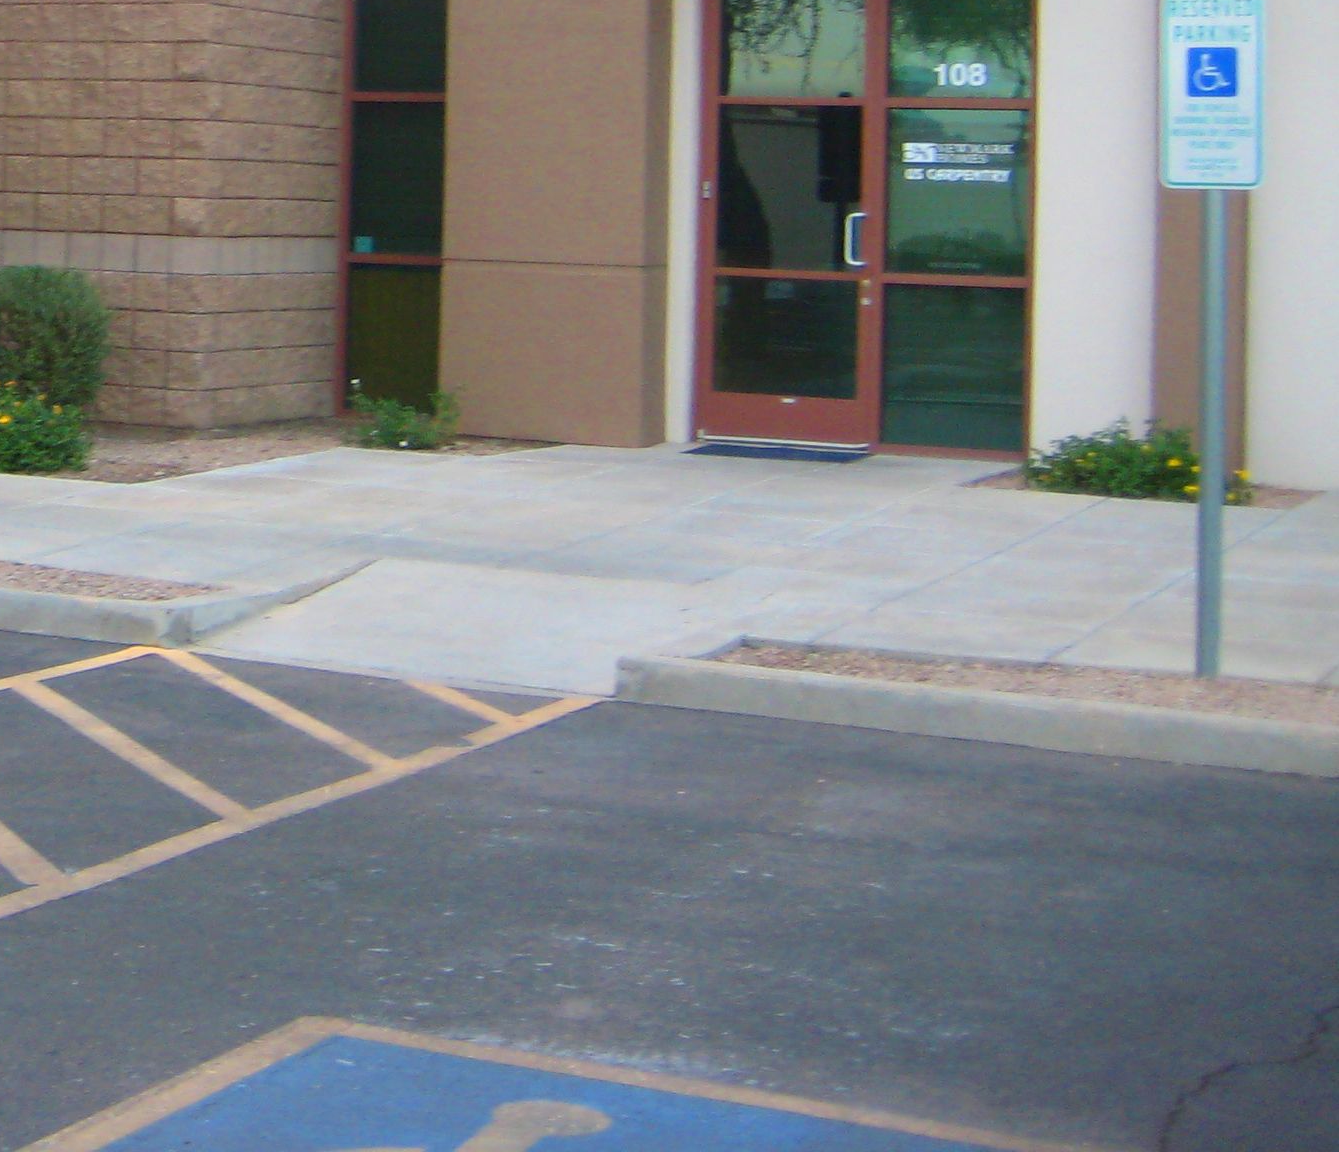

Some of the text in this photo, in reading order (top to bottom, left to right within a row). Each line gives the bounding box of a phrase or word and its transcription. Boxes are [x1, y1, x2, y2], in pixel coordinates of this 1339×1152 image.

[1169, 0, 1253, 17] RESERVED
[1173, 25, 1251, 42] PARKING
[933, 63, 988, 86] 108
